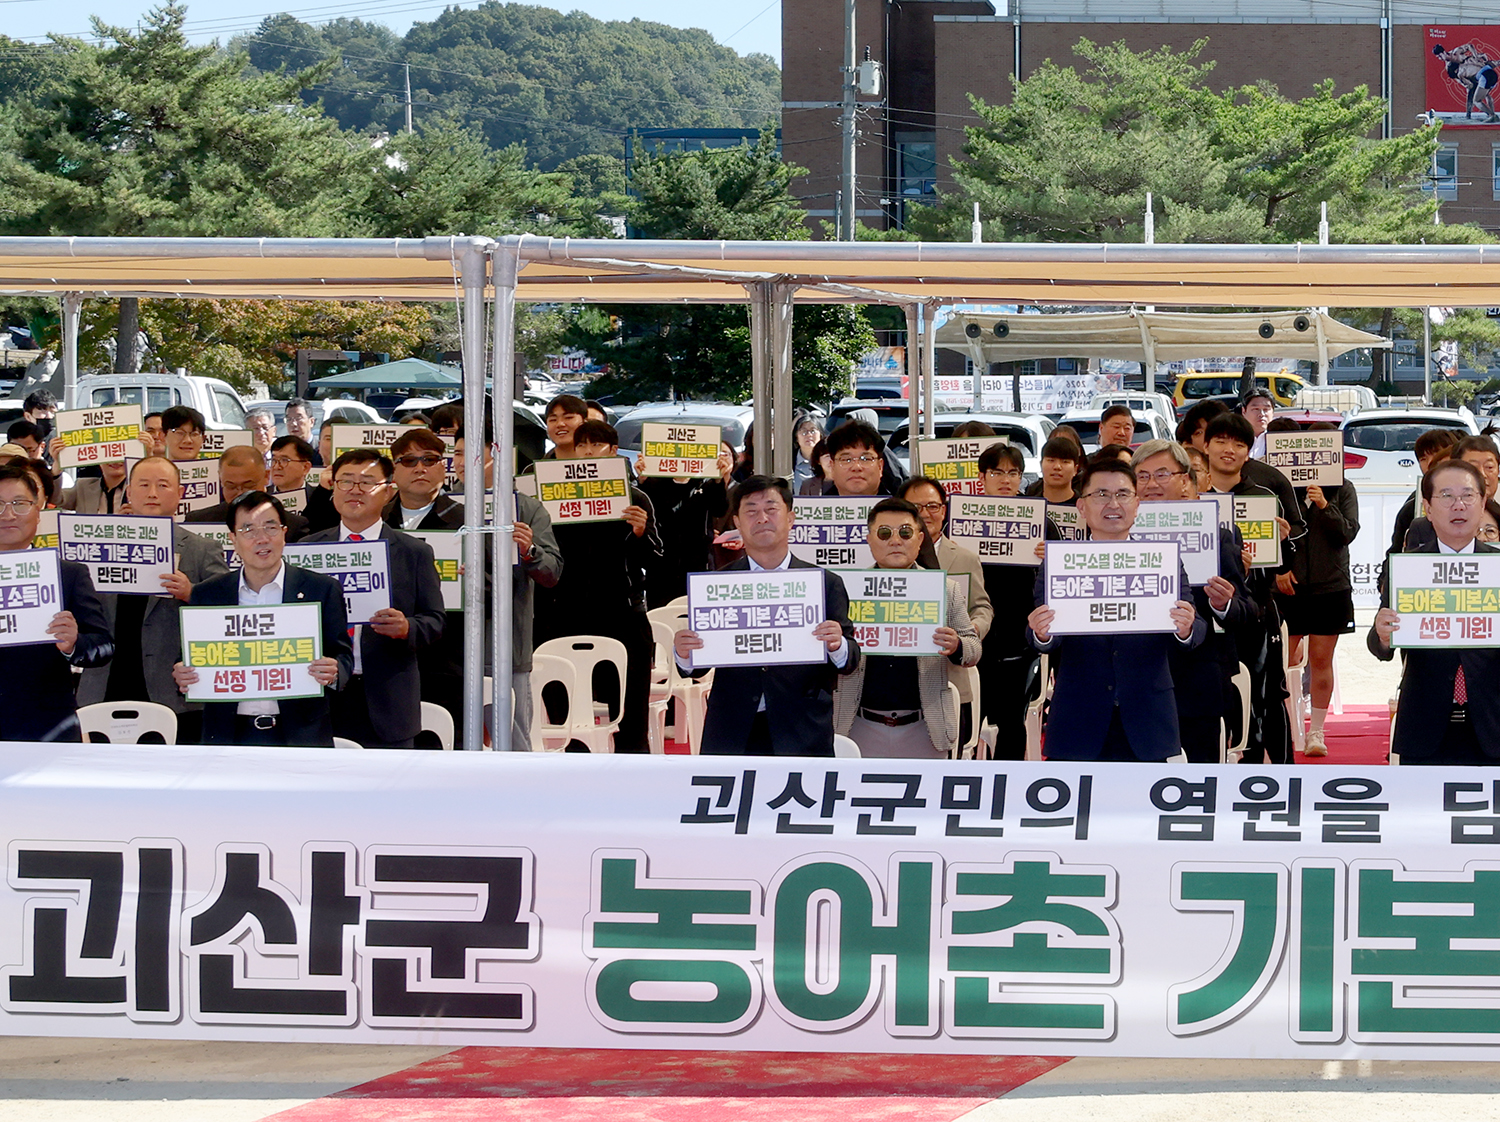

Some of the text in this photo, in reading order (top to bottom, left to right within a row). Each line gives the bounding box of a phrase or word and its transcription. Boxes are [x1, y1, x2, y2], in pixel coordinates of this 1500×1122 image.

[82, 411, 114, 426] 괴산군
[61, 424, 139, 447] 농어촌 기본소득
[668, 428, 696, 440] 괴산군
[1275, 438, 1333, 449] 인구소멸 없는 괴산
[646, 442, 717, 458] 농어촌 기본소득
[1268, 452, 1340, 466] 농어촌 기본 소득이
[658, 459, 703, 472] 선정 기원!
[923, 463, 958, 480] 농어촌
[186, 482, 217, 498] 소득이
[542, 480, 624, 500] 농어촌 기본소득
[962, 504, 1034, 518] 인구소멸 없는 괴산
[73, 524, 158, 540] 인구소멸 없는 괴산
[64, 544, 169, 563] 농어촌 기본 소득이
[816, 549, 855, 564] 만든다!
[979, 541, 1013, 556] 만든다!
[16, 561, 40, 578] 괴산
[325, 553, 372, 568] 없는 괴산
[343, 571, 385, 592] 소득이
[1432, 562, 1479, 584] 괴산군
[706, 582, 806, 601] 인구소멸 없는 괴산
[1052, 575, 1173, 598] 농어촌 기본 소득이
[696, 606, 818, 630] 농어촌 기본 소득이
[1090, 603, 1136, 622] 만든다!
[224, 613, 275, 636] 괴산군
[1420, 617, 1492, 639] 선정 기원!
[735, 632, 782, 654] 만든다!
[852, 627, 918, 647] 선정 기원!
[190, 641, 314, 666] 농어촌 기본소득
[680, 769, 1093, 841] 괴산군민의
[1150, 775, 1390, 844] 염원을
[8, 847, 531, 1020] 괴산군
[592, 858, 1112, 1030] 농어촌
